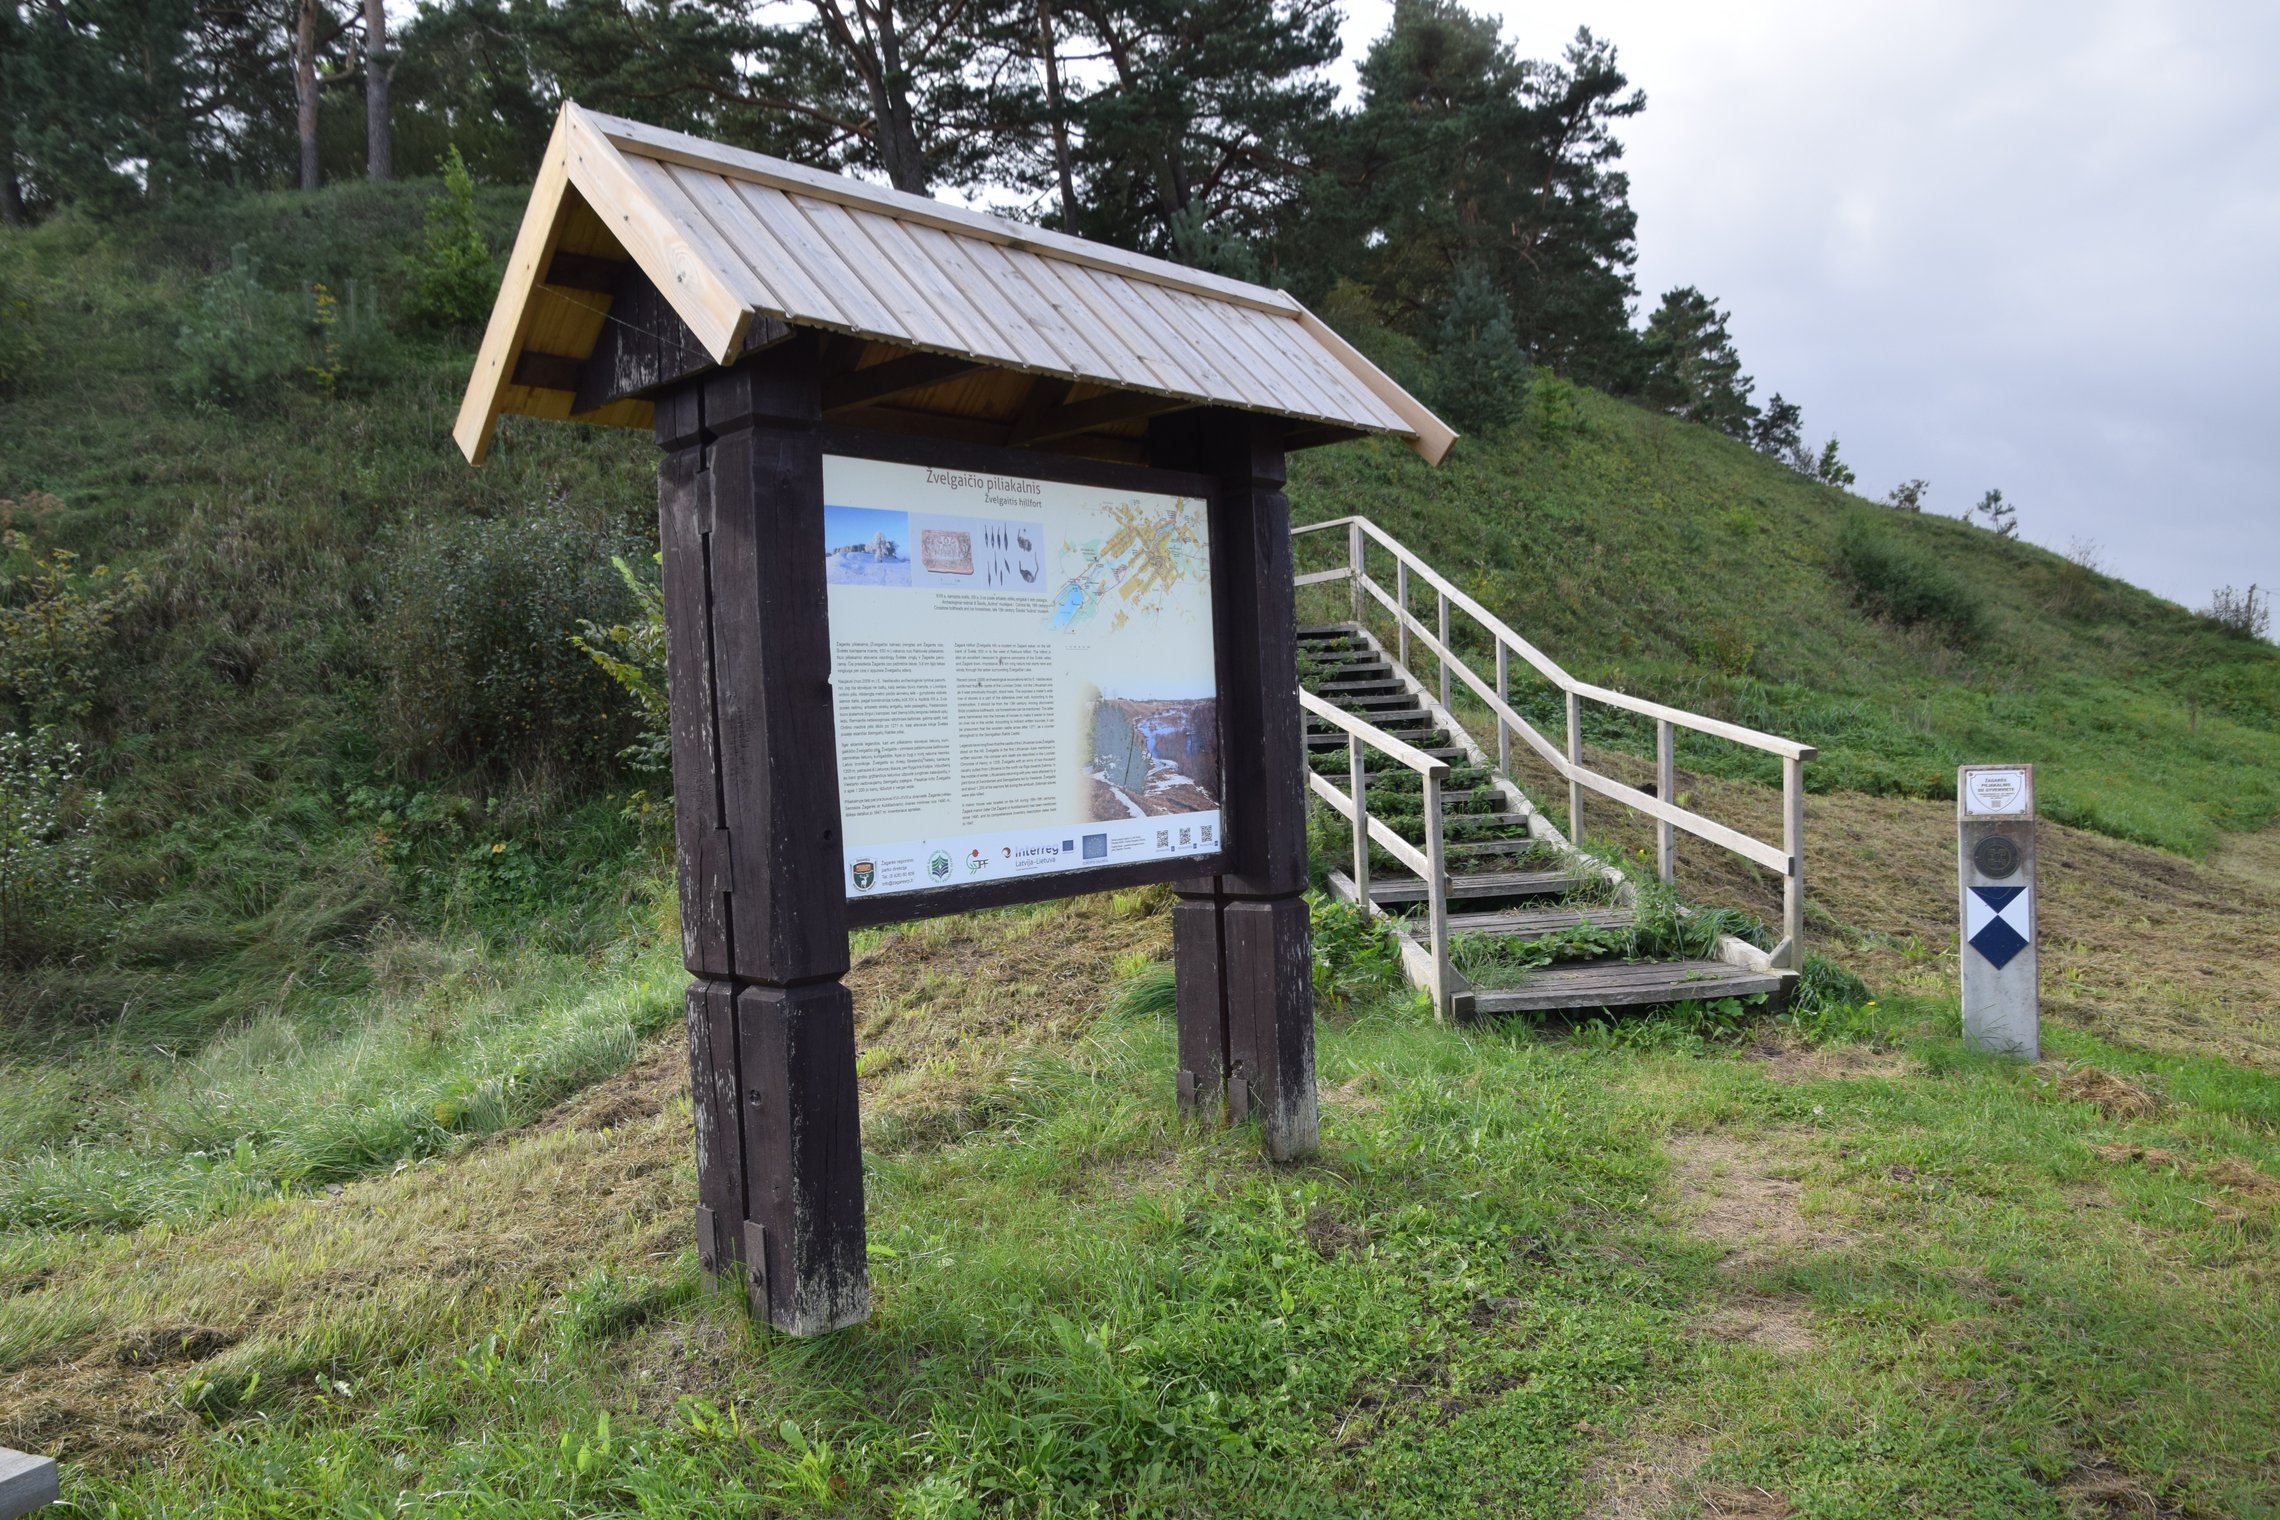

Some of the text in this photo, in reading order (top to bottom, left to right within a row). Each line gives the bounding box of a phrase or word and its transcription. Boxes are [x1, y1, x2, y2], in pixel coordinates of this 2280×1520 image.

[926, 467, 1041, 495] Žvelgaičio piliakalnis
[984, 493, 1042, 508] Žvelgaitis hillfort
